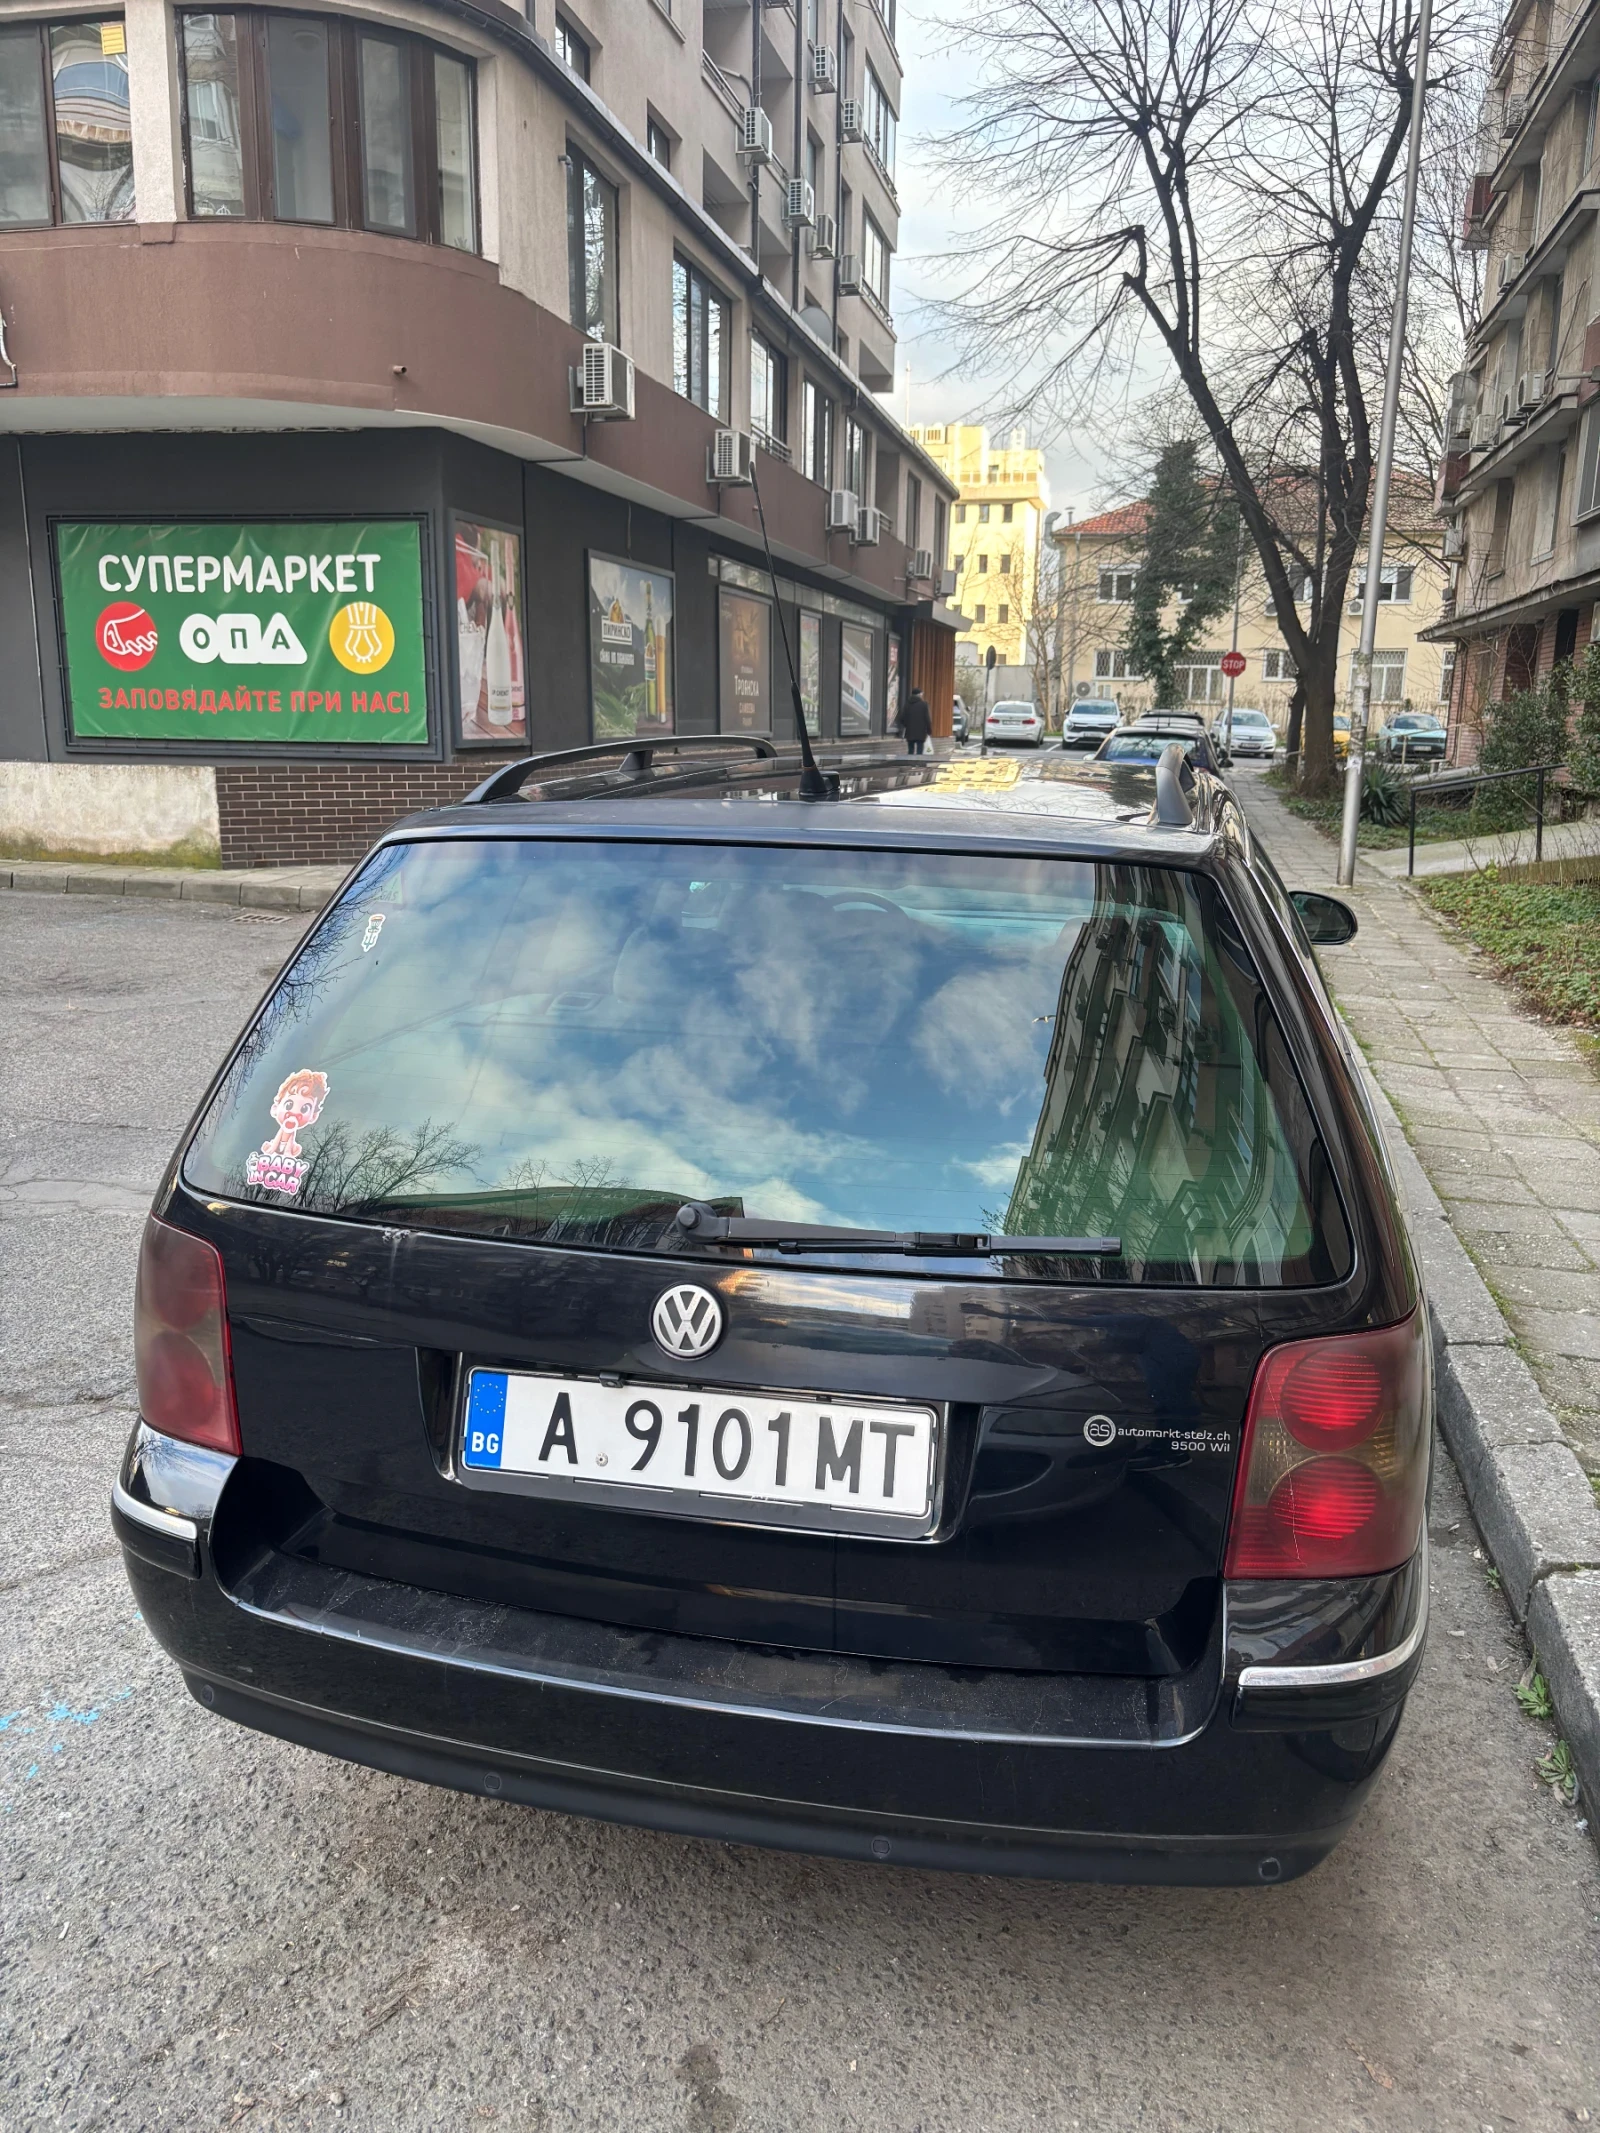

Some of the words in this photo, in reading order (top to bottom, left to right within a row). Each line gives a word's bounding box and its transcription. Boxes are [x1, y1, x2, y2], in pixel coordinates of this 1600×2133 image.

[99, 554, 381, 593] СУПЕРМАРКЕТ
[1222, 660, 1245, 669] STOP
[98, 685, 281, 714] ЗАПОВЯДАЙТЕ
[290, 690, 341, 713] ПРИ
[351, 690, 410, 714] НАС!
[257, 1155, 308, 1178] BABY
[249, 1171, 264, 1182] IN
[264, 1171, 300, 1193] CAR
[471, 1431, 500, 1454] BG
[1117, 1428, 1231, 1441] automarkt-stelz.ch
[1170, 1441, 1206, 1452] 9500
[1210, 1442, 1230, 1452] Wil
